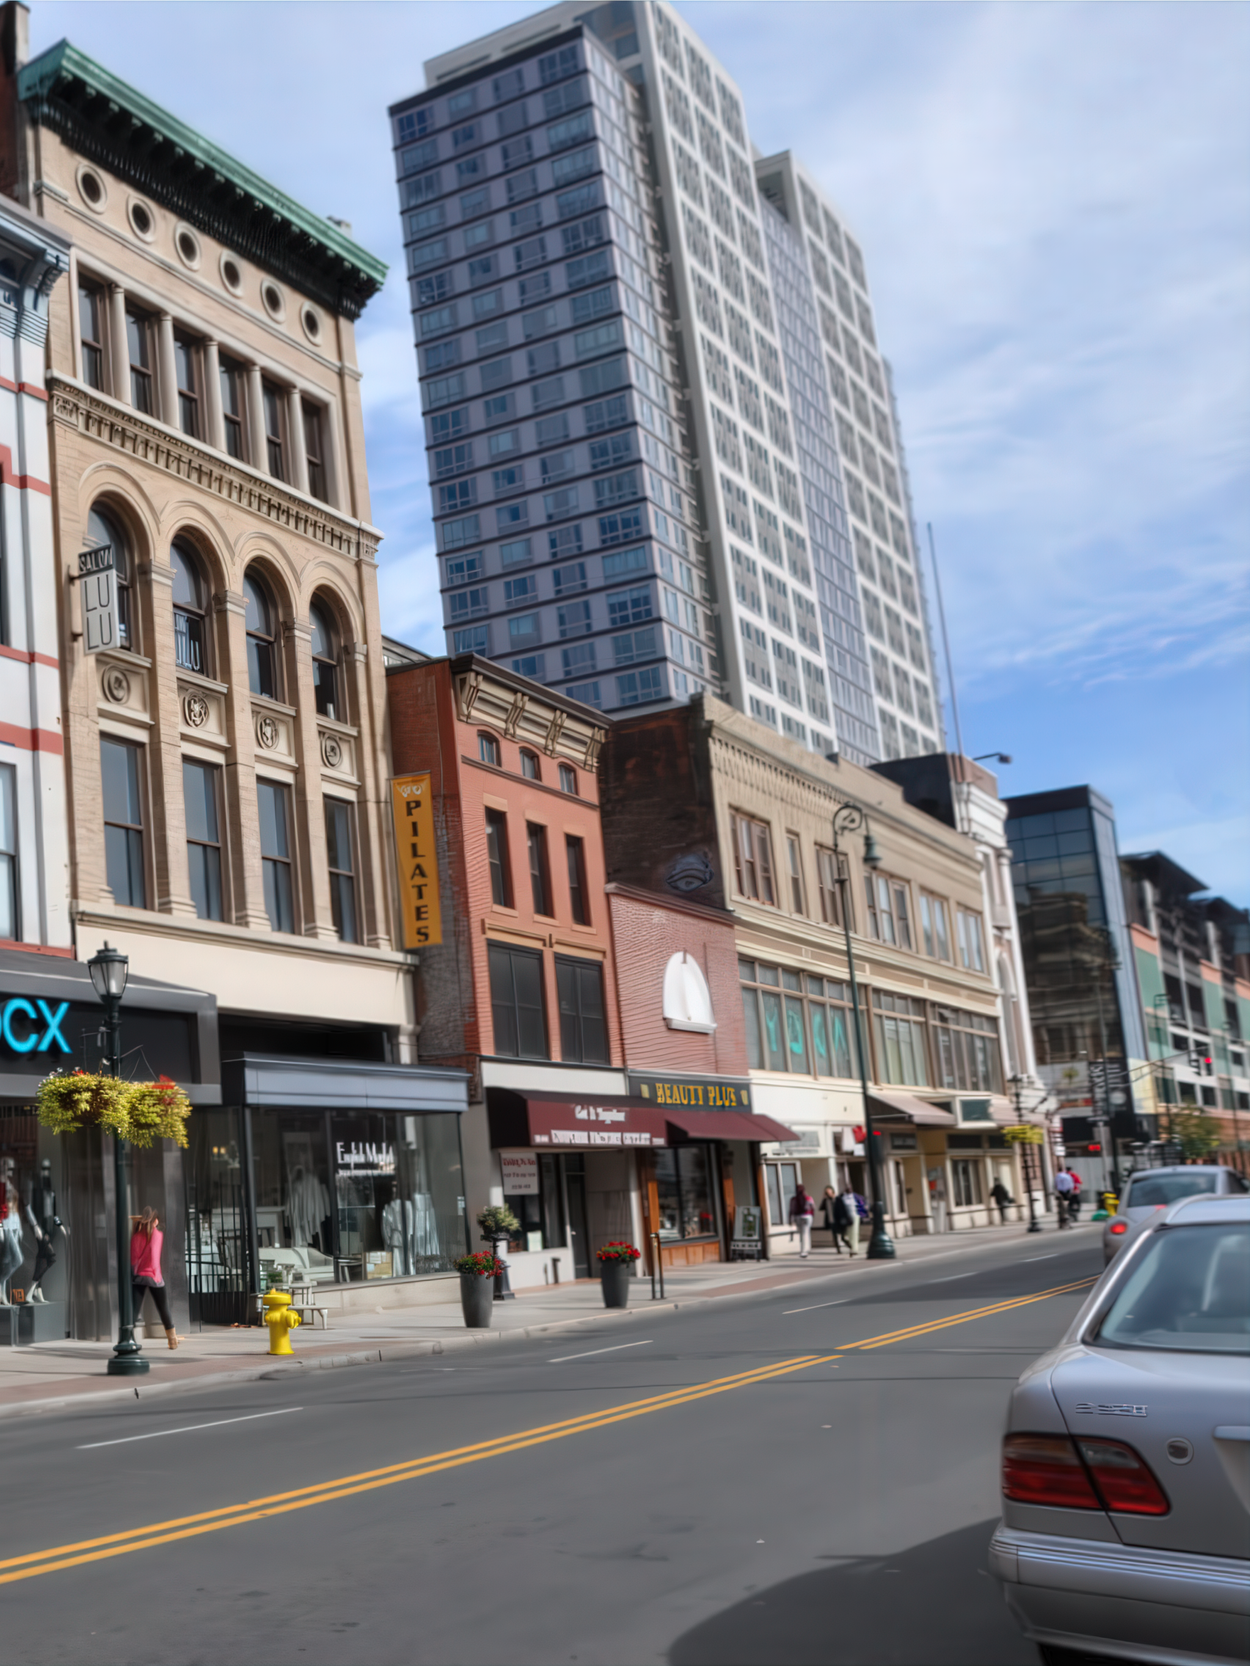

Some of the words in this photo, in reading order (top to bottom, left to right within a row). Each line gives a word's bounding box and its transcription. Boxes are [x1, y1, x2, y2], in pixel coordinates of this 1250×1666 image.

[405, 799, 430, 943] PILATES
[655, 1083, 704, 1105] BEAUTY
[707, 1085, 737, 1106] PLUS
